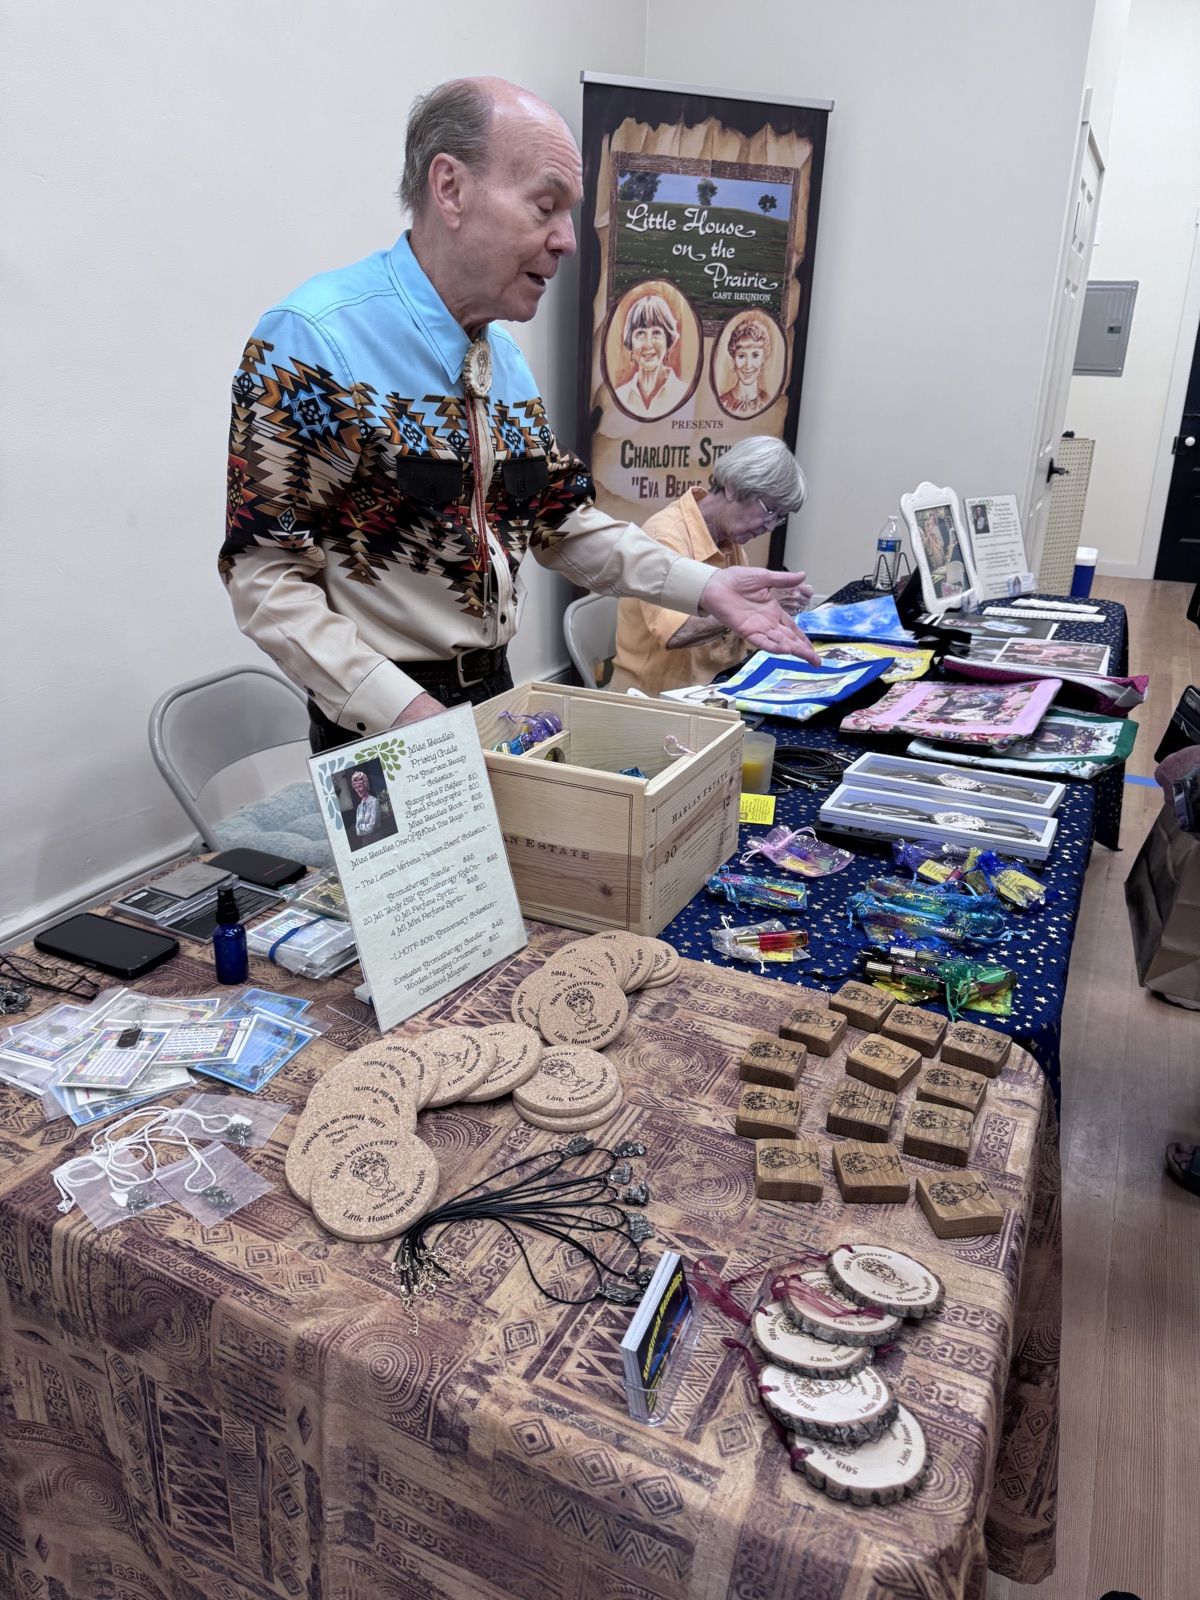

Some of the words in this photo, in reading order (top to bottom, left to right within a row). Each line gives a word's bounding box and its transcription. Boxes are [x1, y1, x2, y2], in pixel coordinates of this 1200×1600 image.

[626, 204, 676, 232] Little
[683, 208, 756, 237] House
[672, 244, 705, 261] on
[711, 238, 735, 258] the
[704, 262, 778, 290] Prairie
[713, 291, 732, 300] CAST
[734, 293, 771, 302] REUNION
[671, 420, 724, 430] PRESENTS
[437, 745, 458, 757] Guide
[526, 838, 590, 859] ESTATE
[375, 868, 396, 881] Lemon
[404, 970, 429, 990] Wooden
[429, 961, 452, 978] Hanging
[419, 975, 446, 995] Oakwood
[563, 981, 606, 992] Anniversary
[554, 1030, 569, 1043] Little
[572, 1036, 591, 1044] House
[601, 1026, 610, 1037] the
[609, 1009, 621, 1029] Prairie
[318, 1123, 330, 1133] the
[368, 1116, 386, 1128] Little
[301, 1133, 319, 1155] Prairie
[330, 1162, 344, 1180] 50th
[344, 1140, 398, 1160] Anniversary
[343, 1210, 363, 1222] Little
[367, 1212, 394, 1222] House
[395, 1206, 405, 1215] on
[404, 1195, 416, 1207] the
[413, 1169, 425, 1196] Prairie
[797, 1397, 816, 1412] 50th
[858, 1402, 878, 1414] Little
[872, 1386, 883, 1401] House
[904, 1423, 912, 1445] House
[898, 1449, 911, 1466] Little
[836, 1461, 858, 1475] 50th
